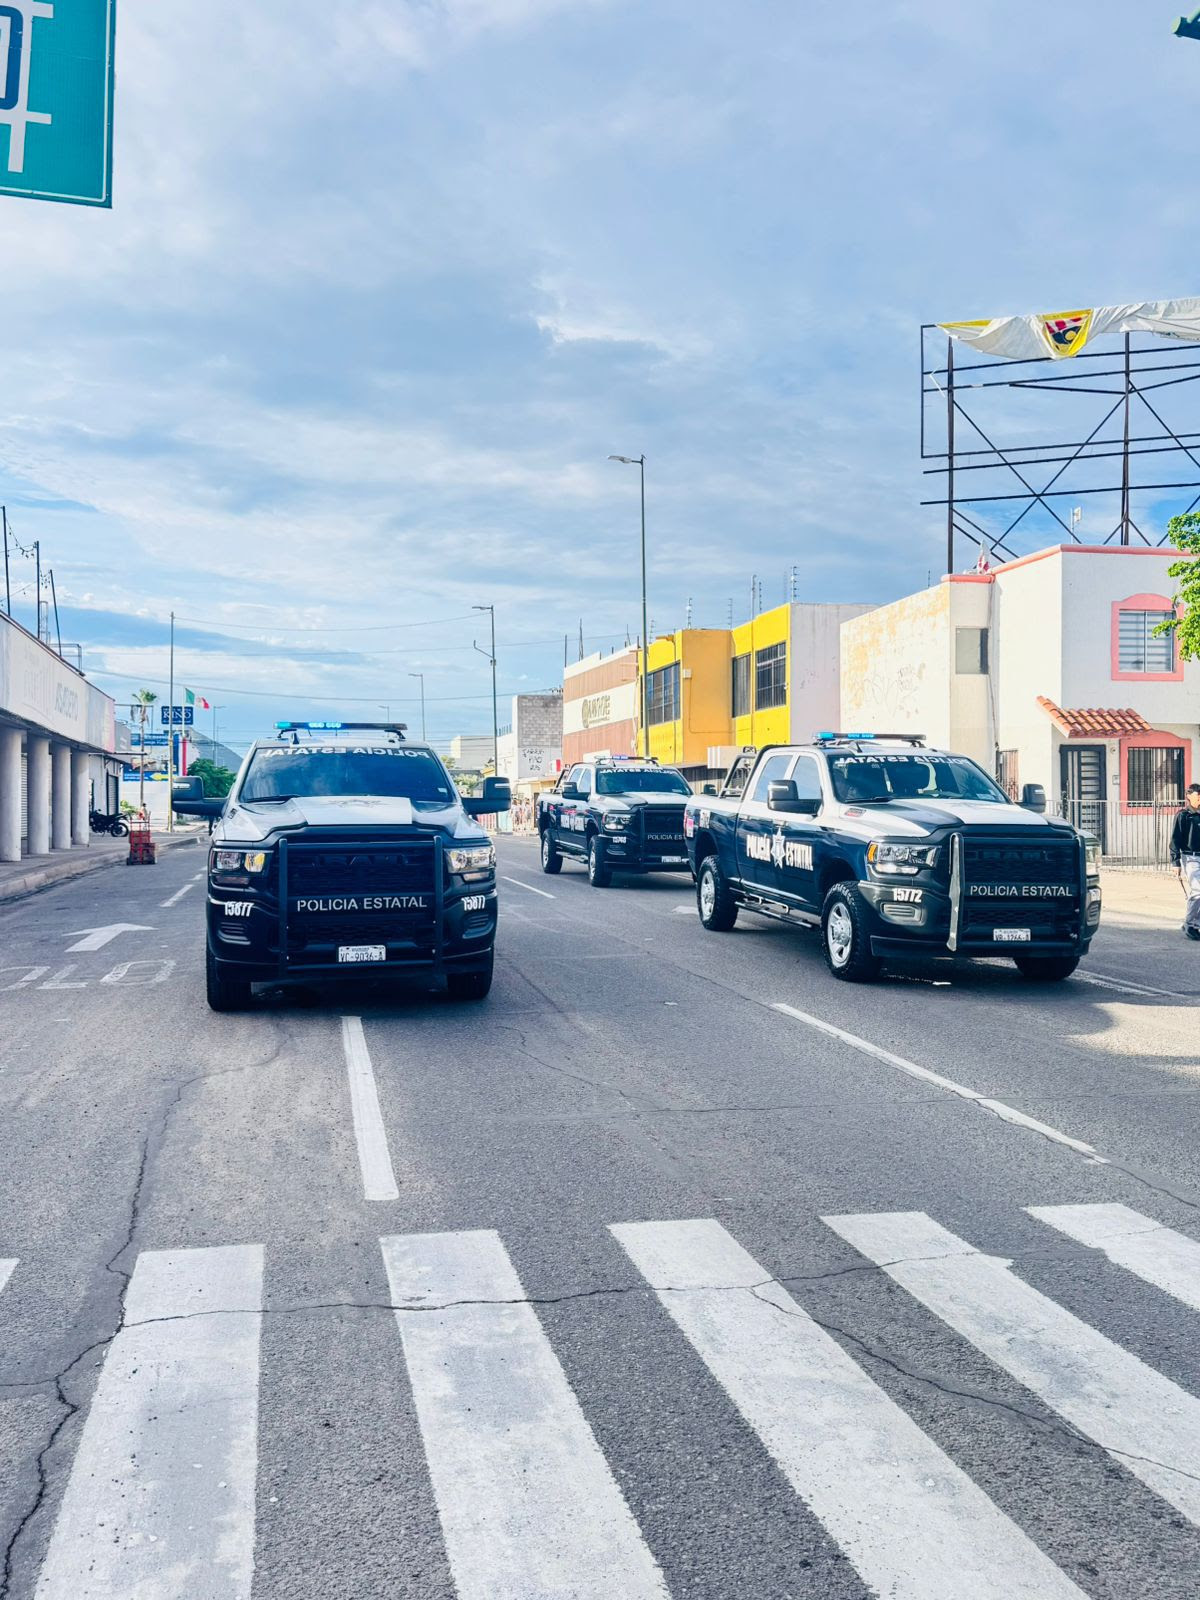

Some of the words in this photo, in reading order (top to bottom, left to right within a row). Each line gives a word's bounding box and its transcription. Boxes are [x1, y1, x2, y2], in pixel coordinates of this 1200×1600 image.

[892, 887, 923, 903] 15772
[970, 885, 1017, 896] POLICIA
[1022, 885, 1073, 897] ESTATAL
[224, 901, 254, 917] 15877
[297, 898, 358, 912] POLICIA
[363, 896, 428, 909] ESTATAL
[461, 895, 486, 911] 15877
